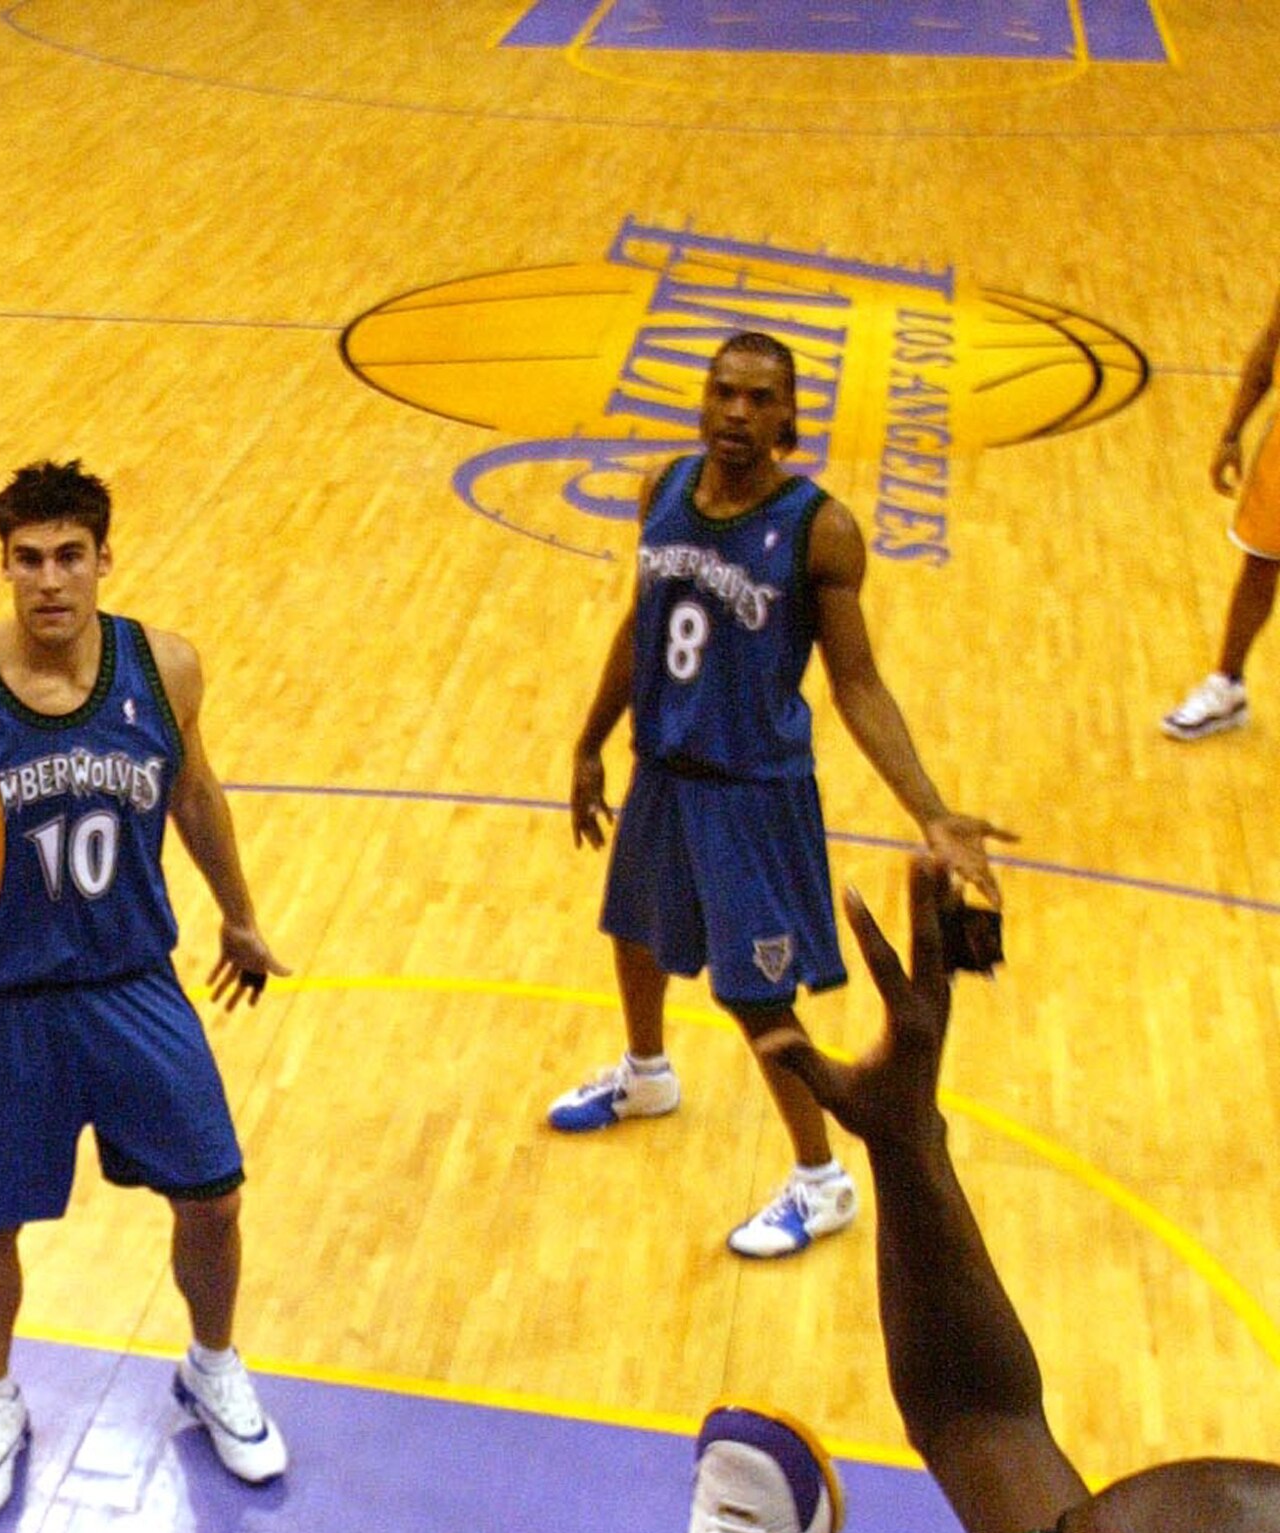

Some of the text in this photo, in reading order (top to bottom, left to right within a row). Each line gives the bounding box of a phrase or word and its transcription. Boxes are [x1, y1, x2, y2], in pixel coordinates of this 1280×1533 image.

[871, 308, 955, 566] LOS ANGELES
[666, 602, 710, 682] 8
[25, 811, 119, 900] 10
